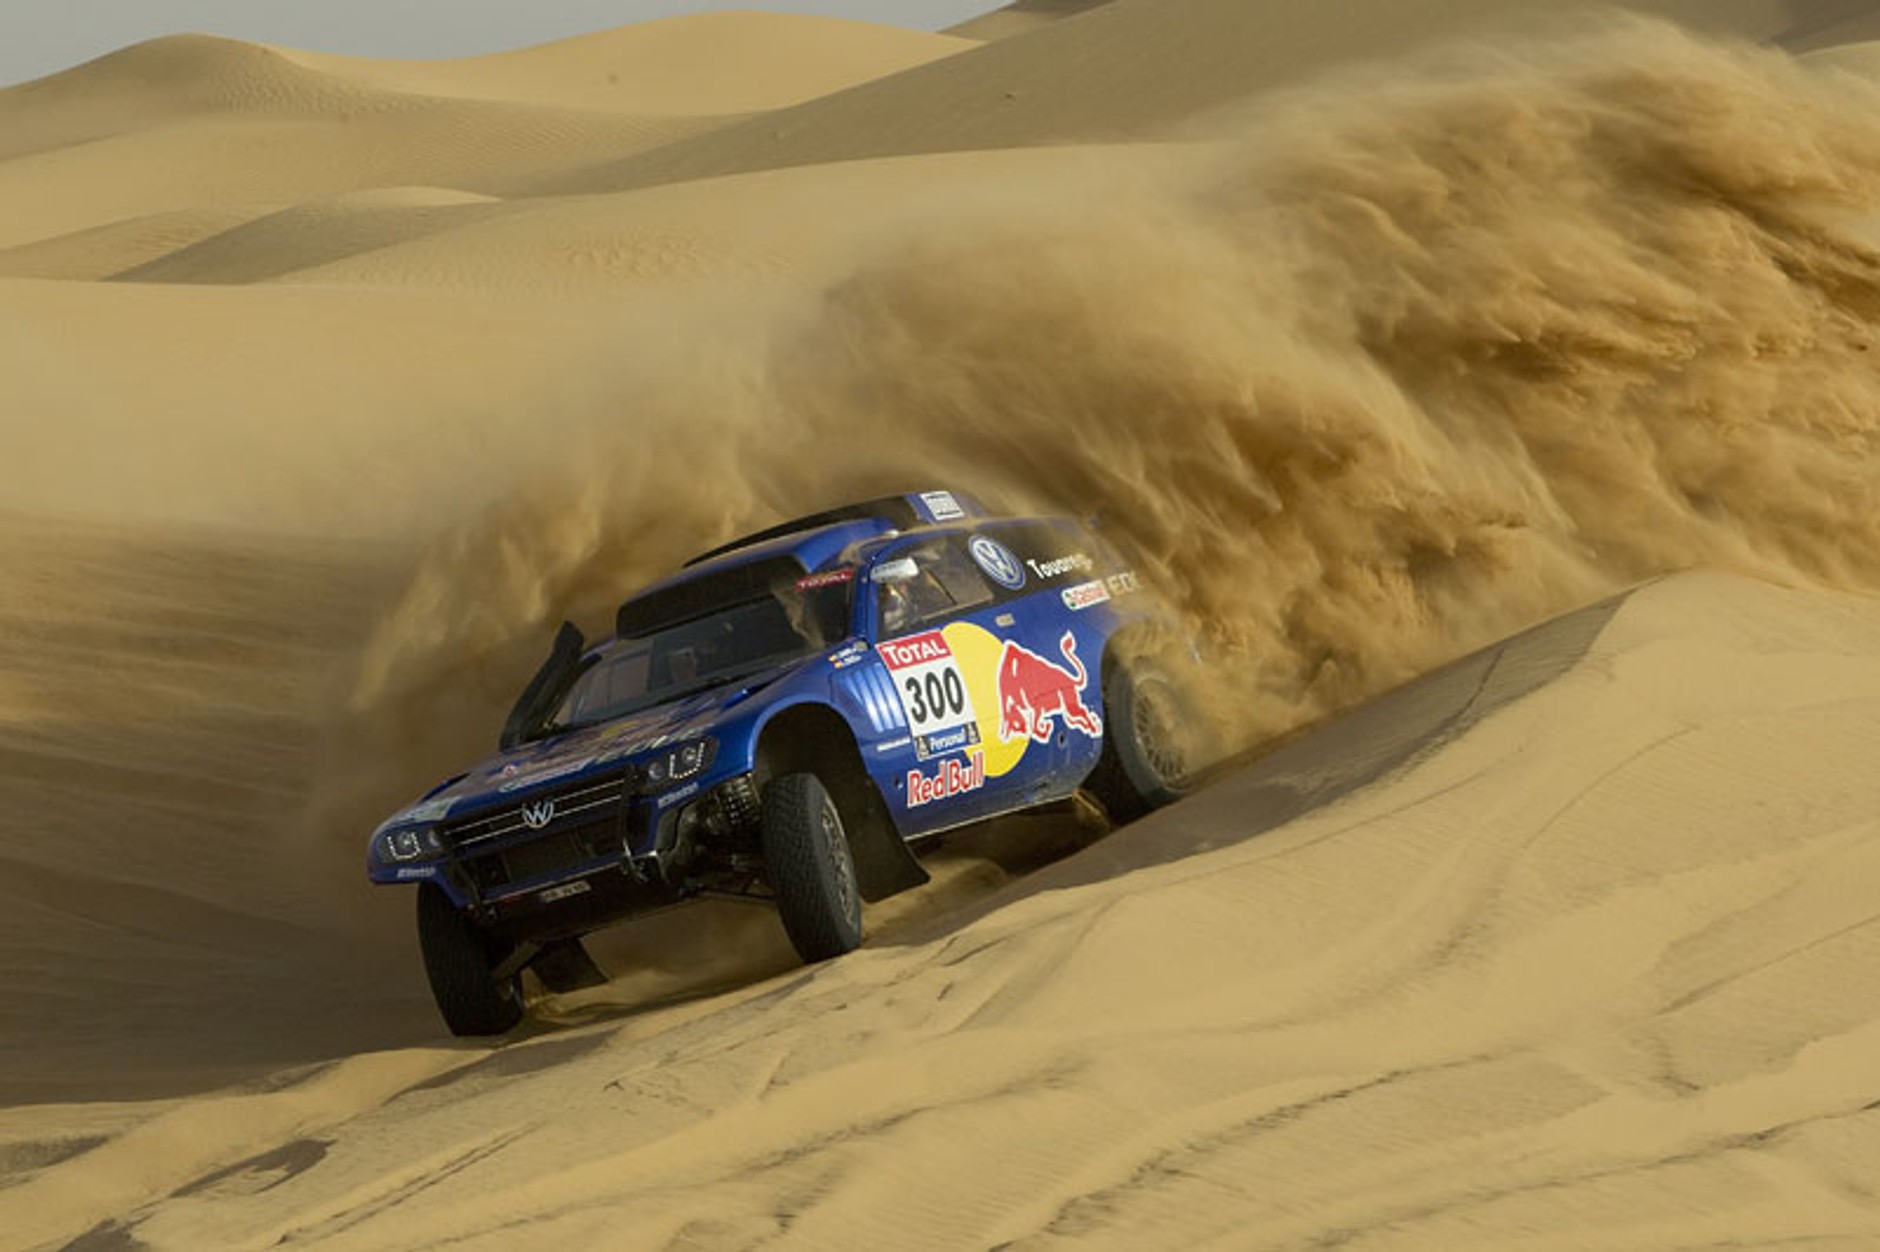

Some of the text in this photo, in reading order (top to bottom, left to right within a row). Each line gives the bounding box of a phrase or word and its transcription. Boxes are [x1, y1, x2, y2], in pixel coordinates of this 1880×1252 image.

[883, 639, 946, 665] TOTAL
[905, 667, 964, 723] 300
[907, 750, 984, 808] Red Bull
